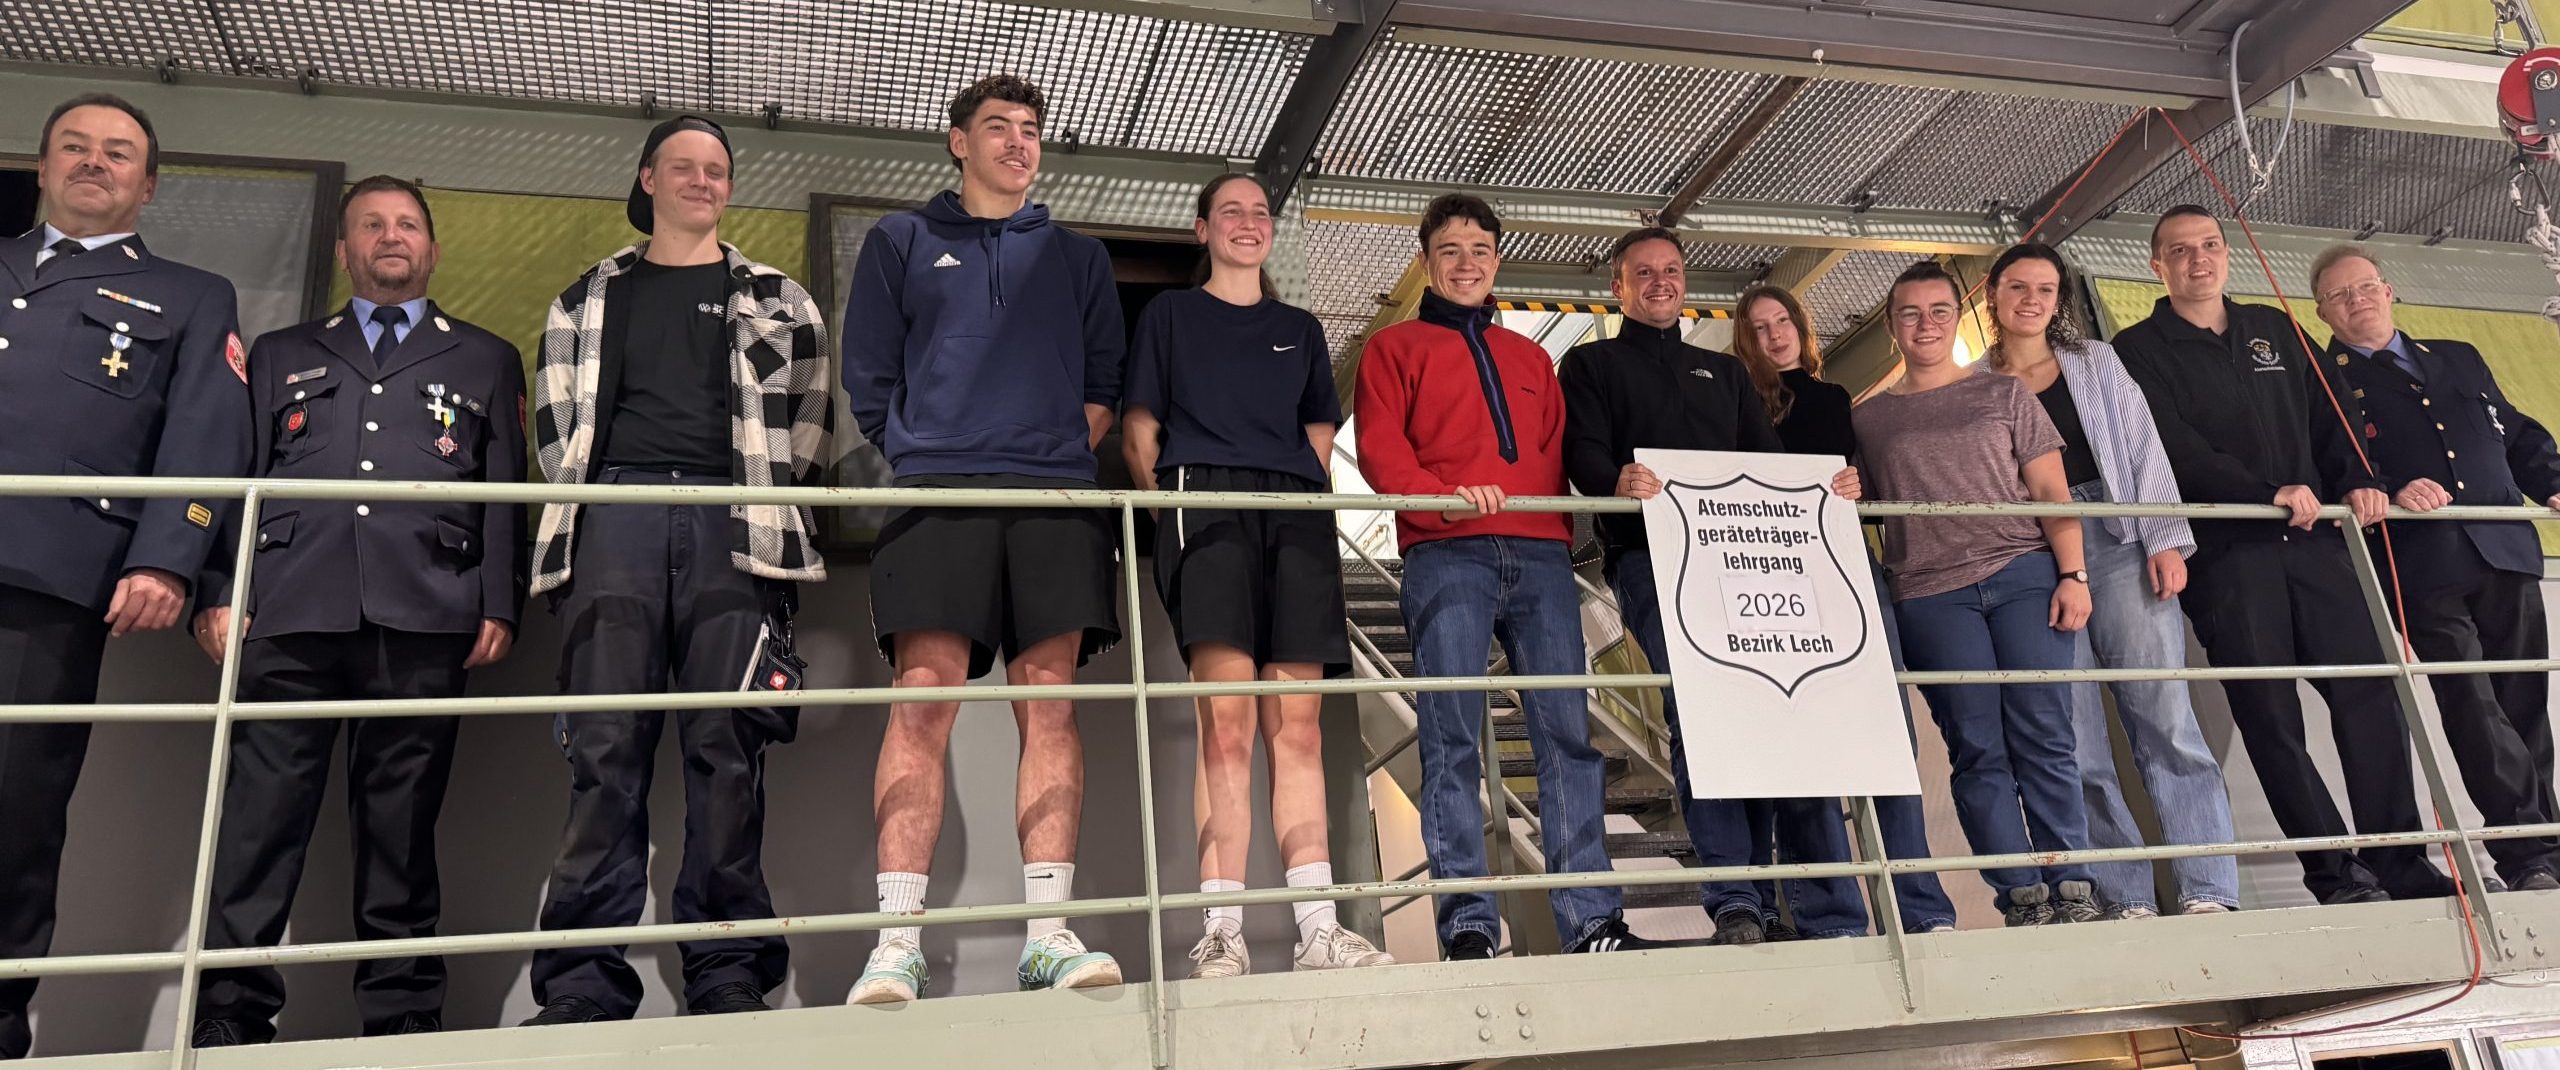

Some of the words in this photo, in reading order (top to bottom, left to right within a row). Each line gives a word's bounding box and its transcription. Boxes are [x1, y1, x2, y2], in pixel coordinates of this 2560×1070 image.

[1698, 498, 1808, 518] Atemschutz-
[1697, 525, 1819, 547] geräteträger-
[1722, 551, 1804, 575] lehrgang
[1736, 592, 1806, 617] 2026
[1726, 633, 1786, 653] Bezirk
[1789, 633, 1834, 653] Lech
